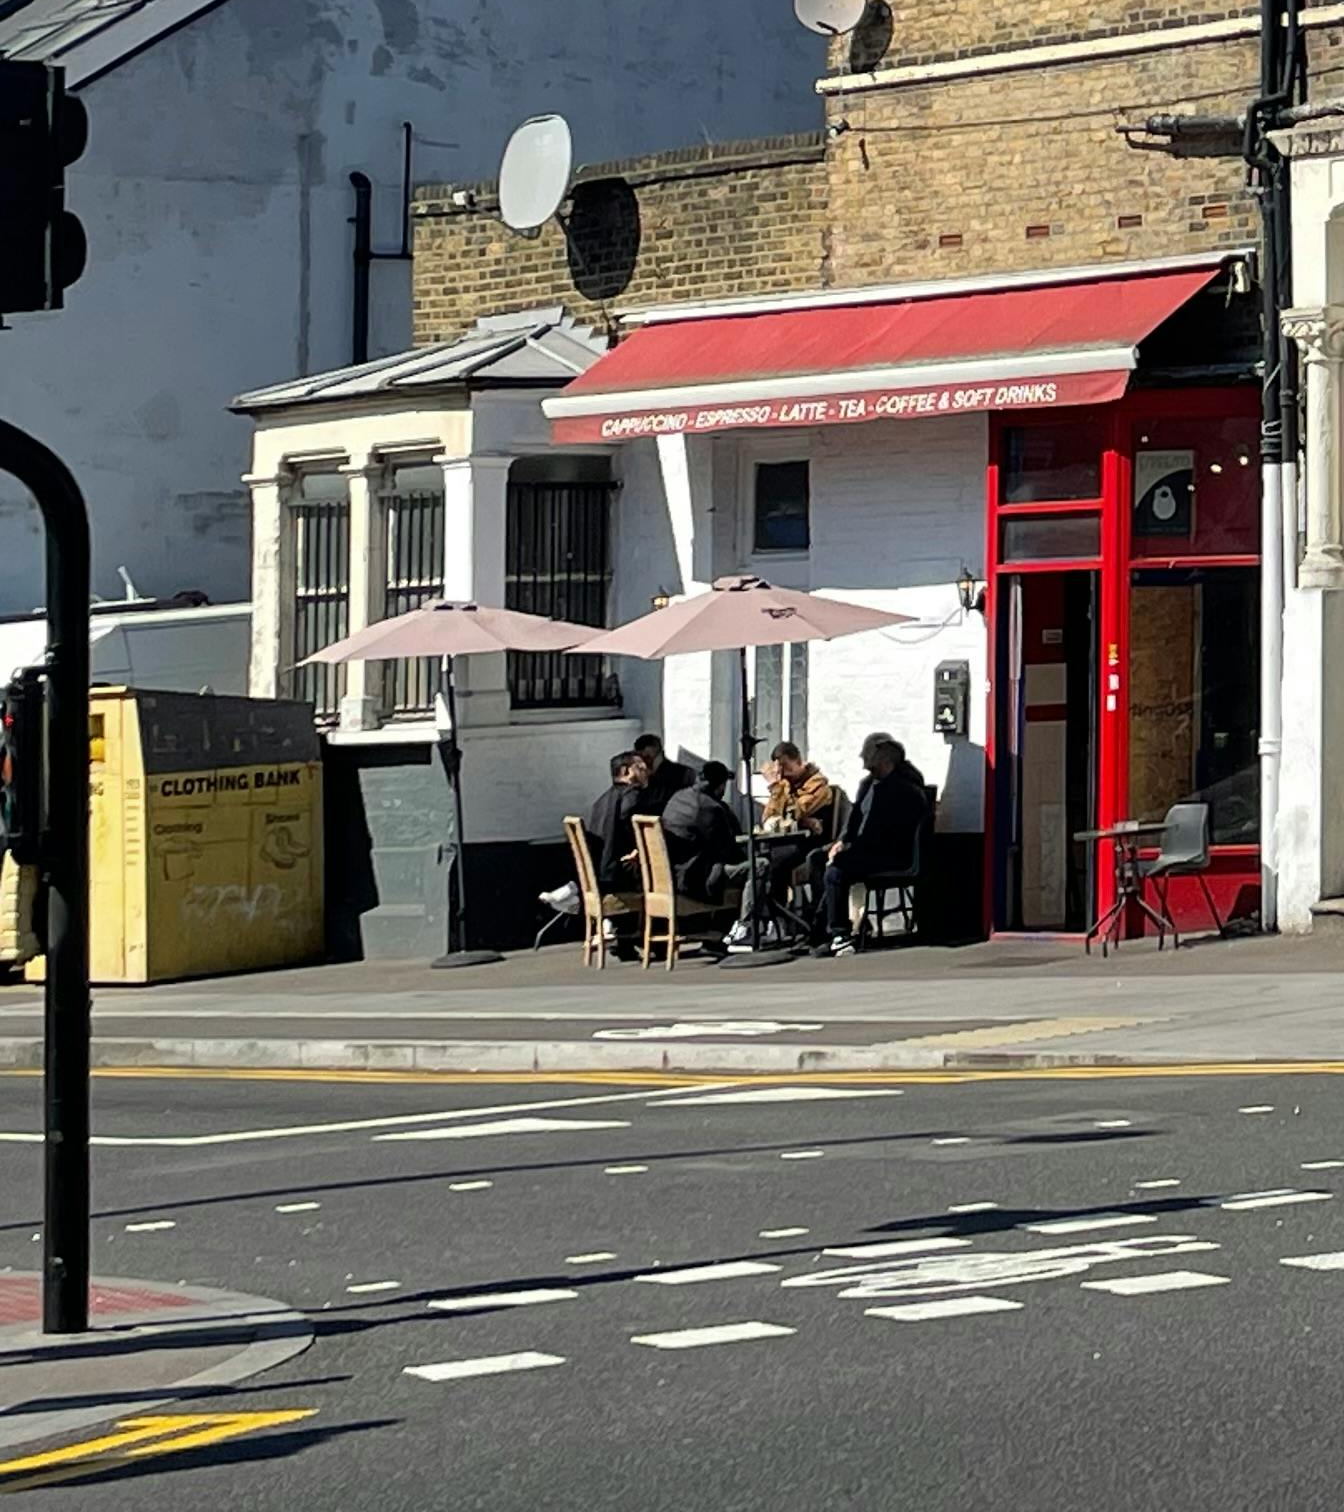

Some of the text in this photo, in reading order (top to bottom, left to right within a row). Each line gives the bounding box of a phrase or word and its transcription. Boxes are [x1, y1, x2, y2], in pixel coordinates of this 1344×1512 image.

[601, 412, 689, 438] CAPPUCCINO
[695, 405, 772, 429] ESPRESSO
[779, 401, 827, 422] LATTE
[838, 399, 866, 419] TEA
[875, 392, 938, 414] COFFEE
[938, 391, 950, 410] &
[952, 387, 995, 409] SOFT
[995, 382, 1057, 406] DRINKS
[161, 768, 301, 798] CLOTHING BANK
[154, 822, 203, 836] Clothing
